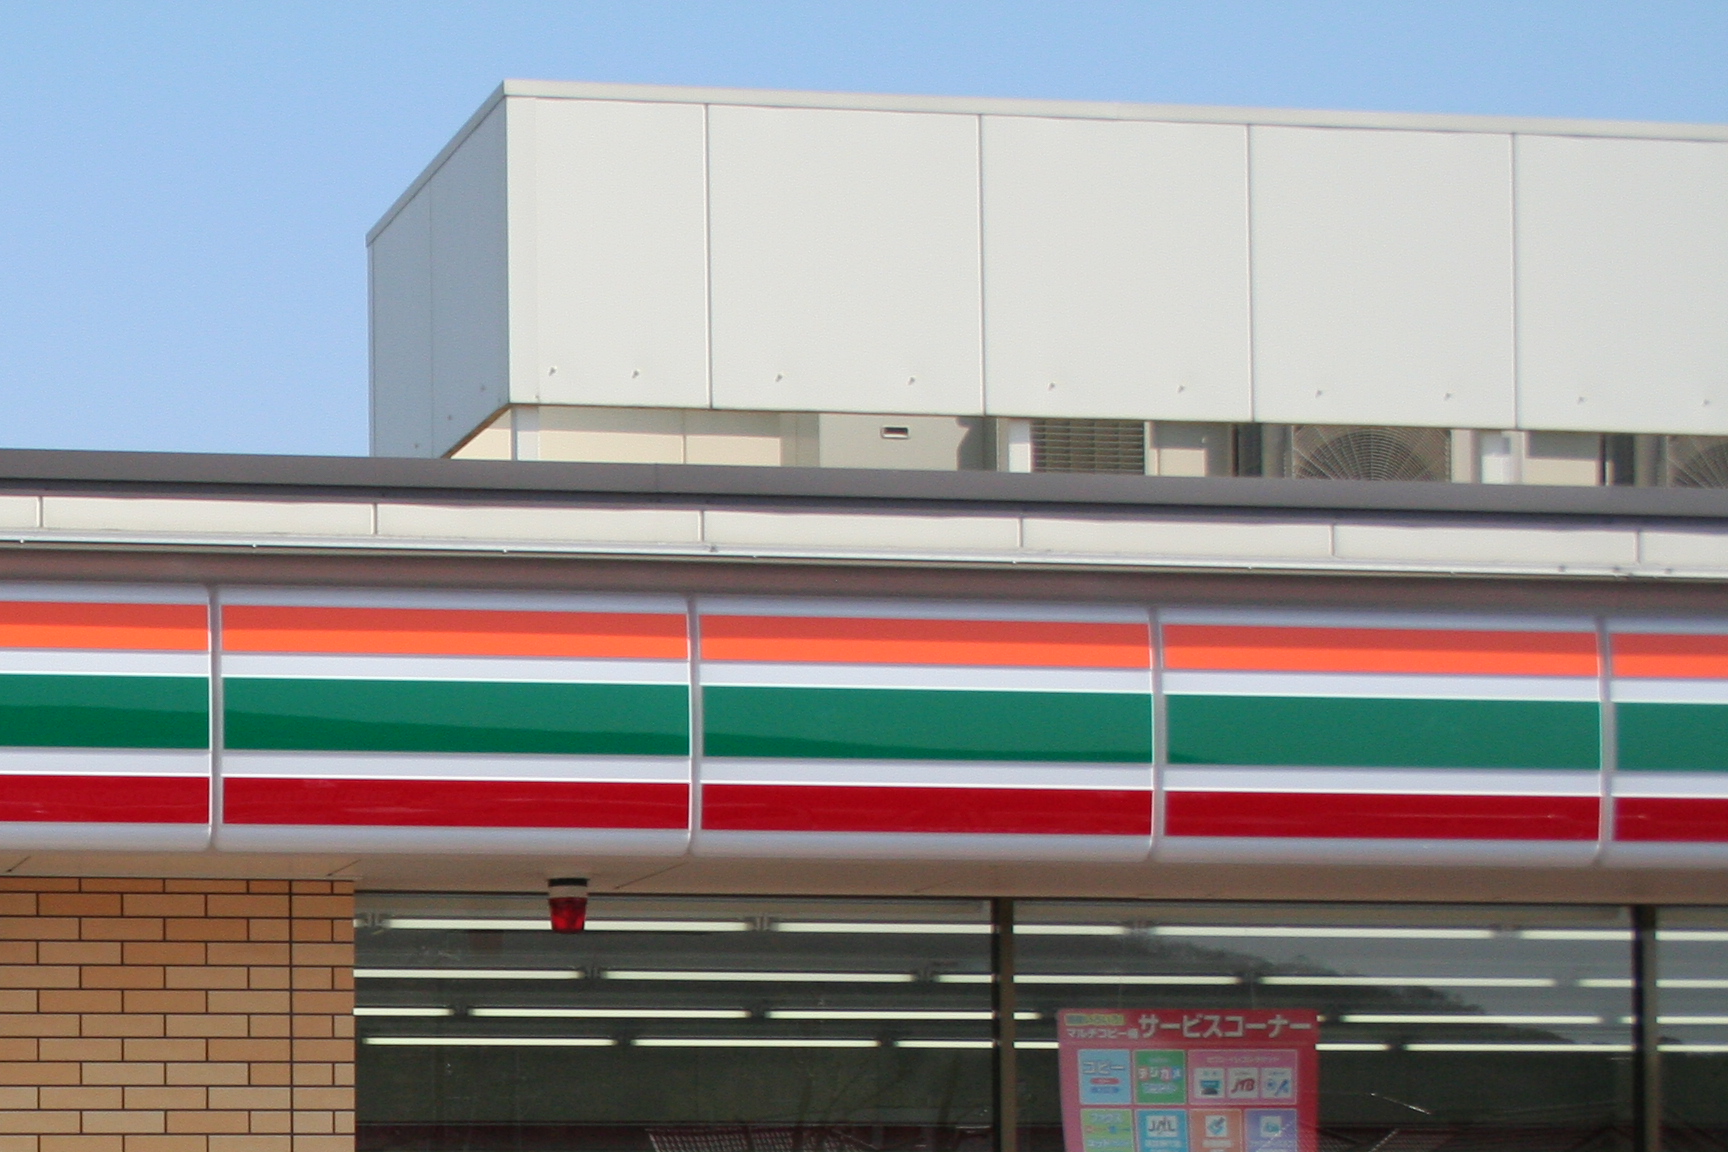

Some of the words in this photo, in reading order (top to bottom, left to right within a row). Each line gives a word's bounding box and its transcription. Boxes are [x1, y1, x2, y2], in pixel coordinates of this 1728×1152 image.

[1138, 1014, 1312, 1038] サービスコーナー
[1082, 1060, 1125, 1075] コピー
[1231, 1077, 1255, 1093] JTB
